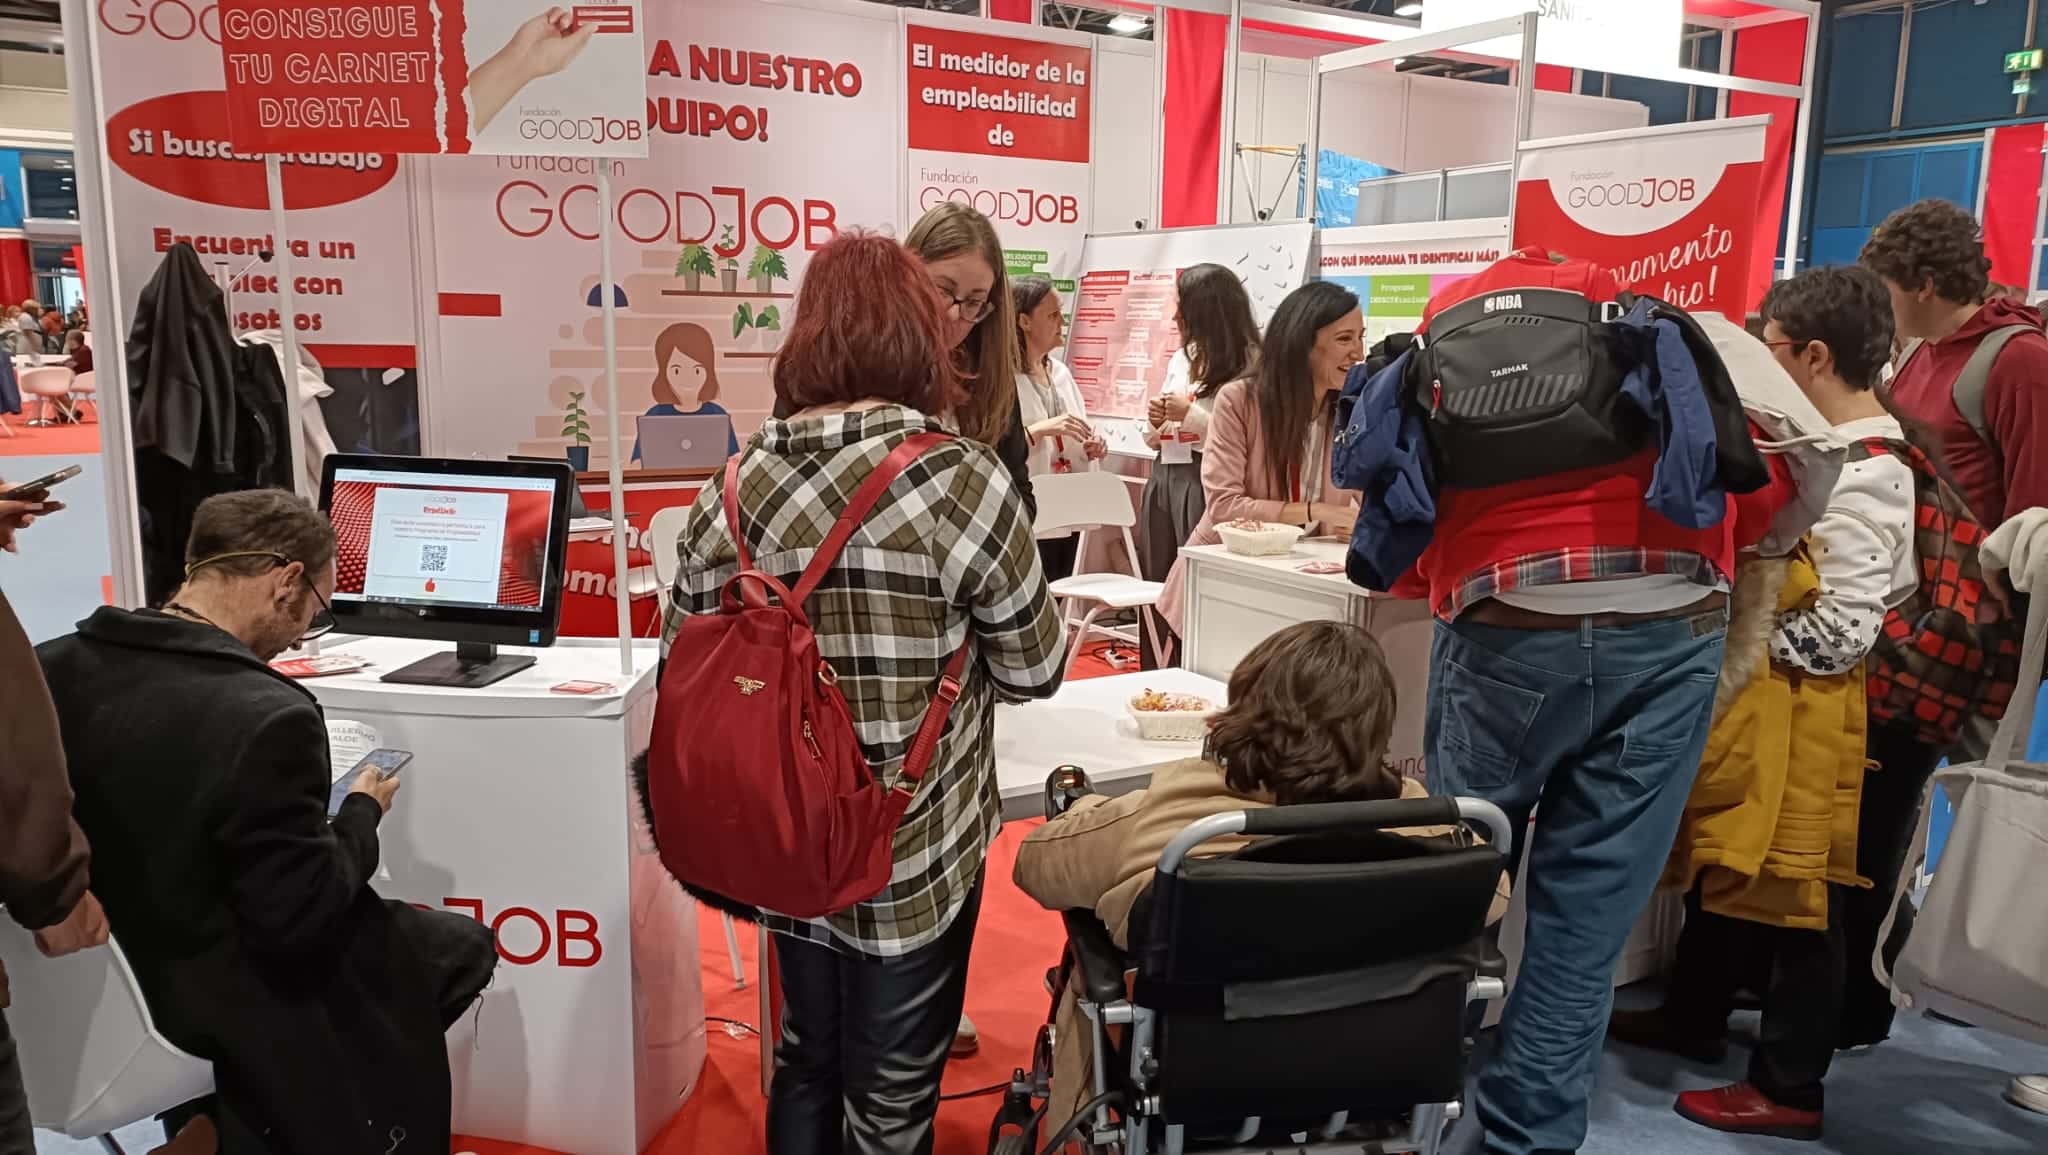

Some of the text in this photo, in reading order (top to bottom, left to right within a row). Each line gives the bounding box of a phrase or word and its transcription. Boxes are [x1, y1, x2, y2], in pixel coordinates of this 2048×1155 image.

[224, 6, 418, 39] CONSIGUE
[229, 51, 430, 84] TU CARNET
[648, 39, 862, 98] A NUESTRO
[912, 43, 1086, 86] El medidor de la
[258, 97, 410, 129] DIGITAL
[921, 86, 1077, 119] empleabilidad
[128, 128, 152, 154] Si
[519, 117, 642, 144] GOODJOB
[987, 123, 1015, 147] de
[1568, 178, 1696, 208] GOODJOB
[319, 241, 356, 259] un
[1341, 253, 1358, 268] QUÉ
[1359, 253, 1407, 267] PROGRAMA
[1408, 252, 1418, 265] TE
[1420, 250, 1474, 265] IDENTIFICAS
[294, 275, 344, 296] con
[1495, 294, 1523, 311] NBA
[1490, 363, 1529, 378] TARMAK
